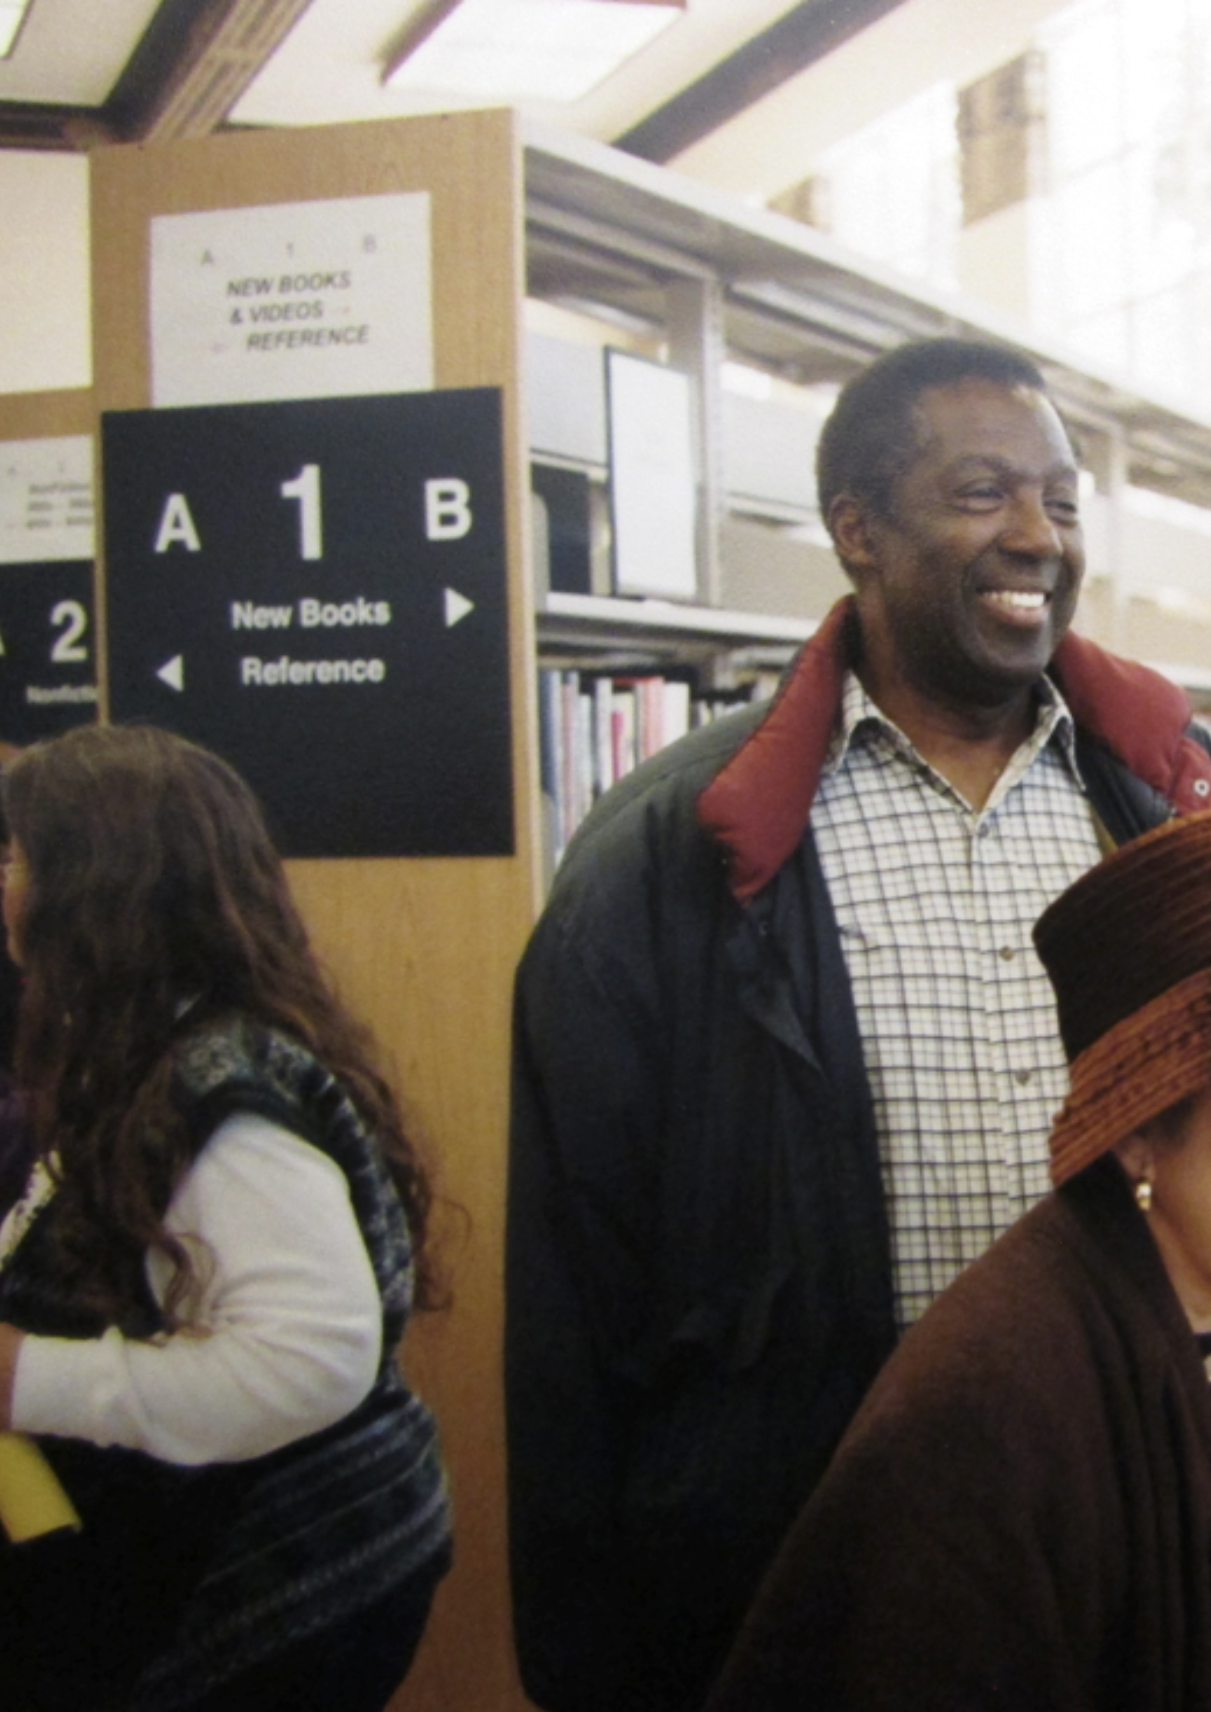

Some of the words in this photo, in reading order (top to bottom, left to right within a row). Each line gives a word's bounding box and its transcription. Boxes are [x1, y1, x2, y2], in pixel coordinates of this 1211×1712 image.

[200, 249, 214, 265] A
[227, 277, 273, 296] NEW
[279, 271, 351, 293] BOOKS
[230, 308, 243, 324] &
[250, 301, 324, 323] VIDEOS
[247, 325, 369, 350] REFERENCE
[155, 493, 201, 553] A
[281, 464, 323, 561] 1
[424, 477, 474, 541] B
[231, 602, 292, 630] New
[299, 597, 391, 628] Books
[51, 600, 87, 661] 2
[241, 656, 386, 685] Reference
